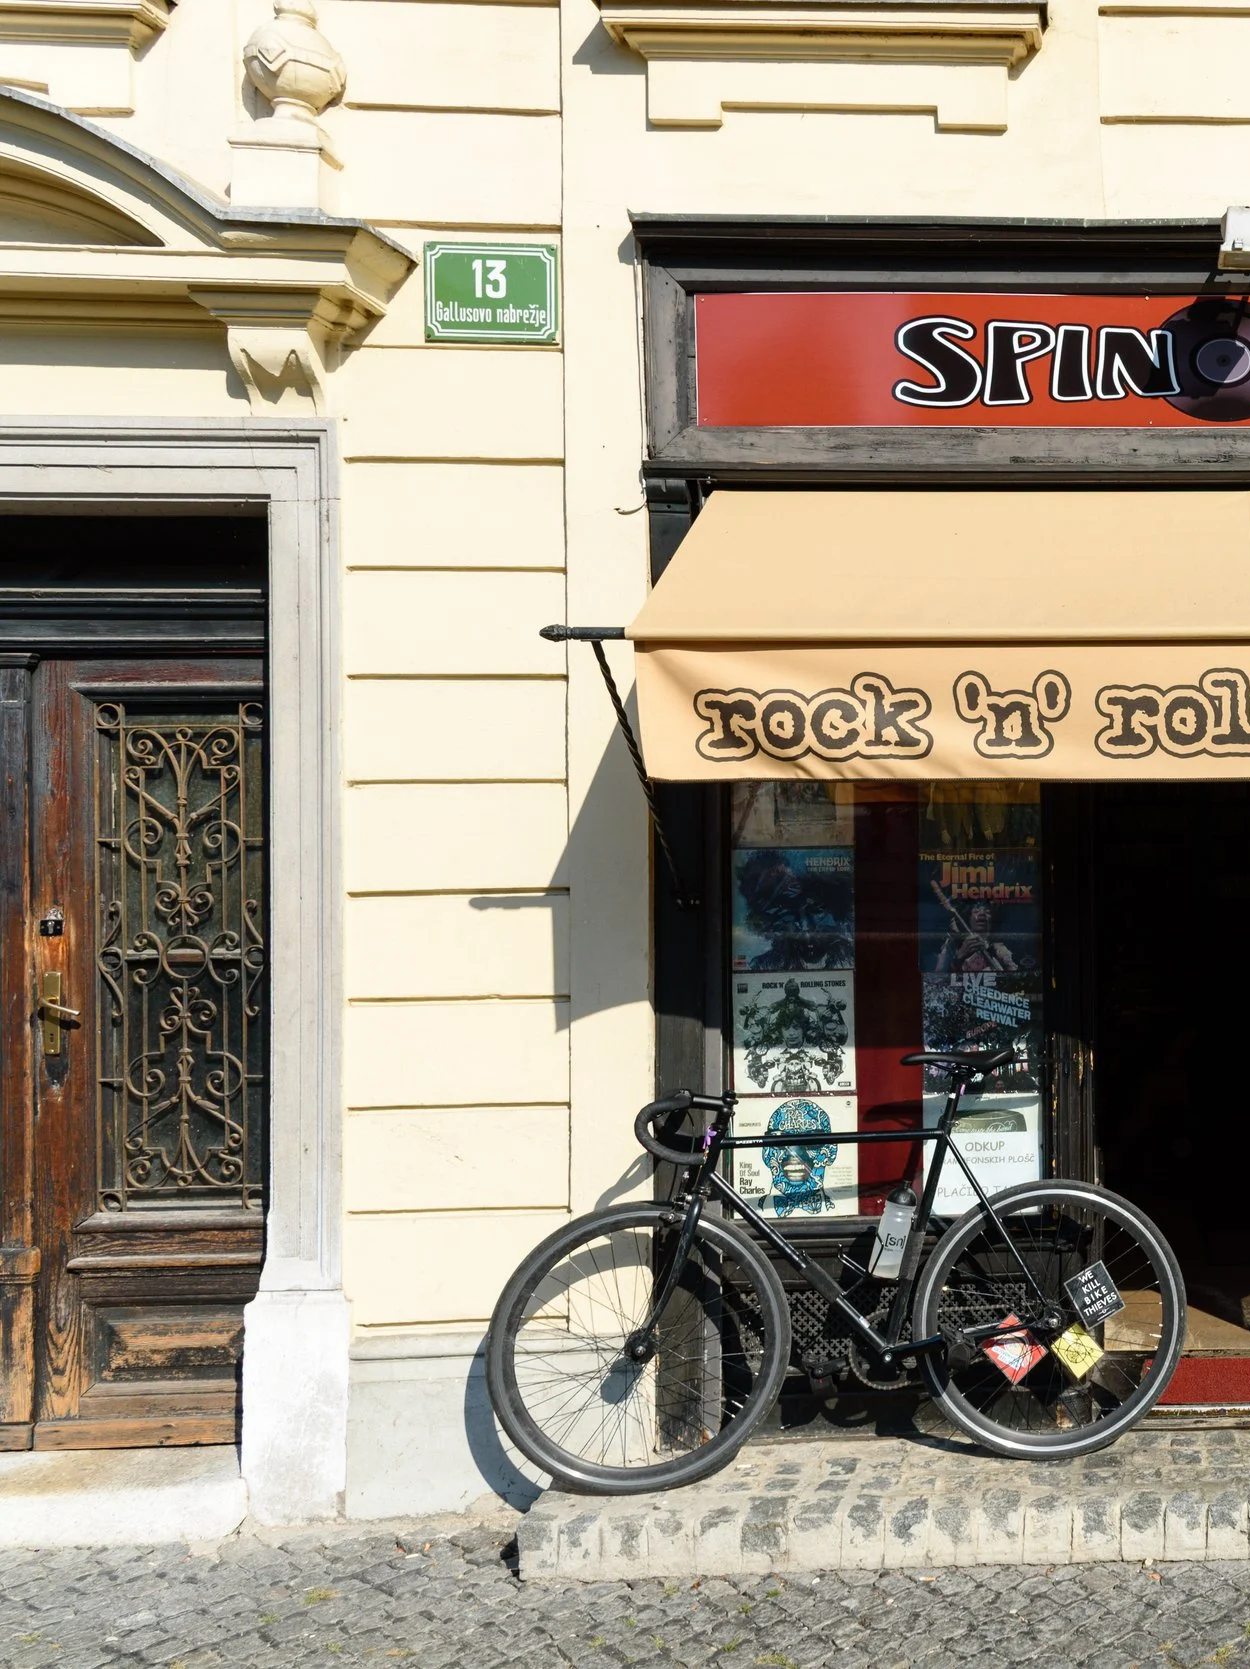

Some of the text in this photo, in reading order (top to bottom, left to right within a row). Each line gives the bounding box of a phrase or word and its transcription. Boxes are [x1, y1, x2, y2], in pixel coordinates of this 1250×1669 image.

[472, 259, 507, 299] 13
[436, 301, 546, 327] Gallusovo nabrežje
[892, 315, 1183, 407] SPIN
[696, 674, 932, 760] rock
[805, 856, 851, 867] HENDRIX
[919, 853, 995, 861] The Eternal Fire of
[940, 861, 995, 887] Jimi
[951, 882, 1032, 899] Hendrix
[950, 972, 998, 987] LIVE
[964, 982, 1030, 1009] CREEDENCE
[962, 991, 1031, 1020] CLEARWATER
[976, 1009, 1019, 1028] REVIVAL
[778, 1118, 818, 1130] CHARLES
[964, 1141, 1005, 1152] ODKUP
[942, 1153, 1036, 1165] AMFONSKIH PLOŠČ
[739, 1178, 753, 1186] Ray
[739, 1186, 765, 1194] Charles
[1078, 1270, 1094, 1284] WE
[1081, 1279, 1101, 1294] KILL
[1084, 1285, 1108, 1305] BIKE
[1083, 1291, 1118, 1317] THIEVES
